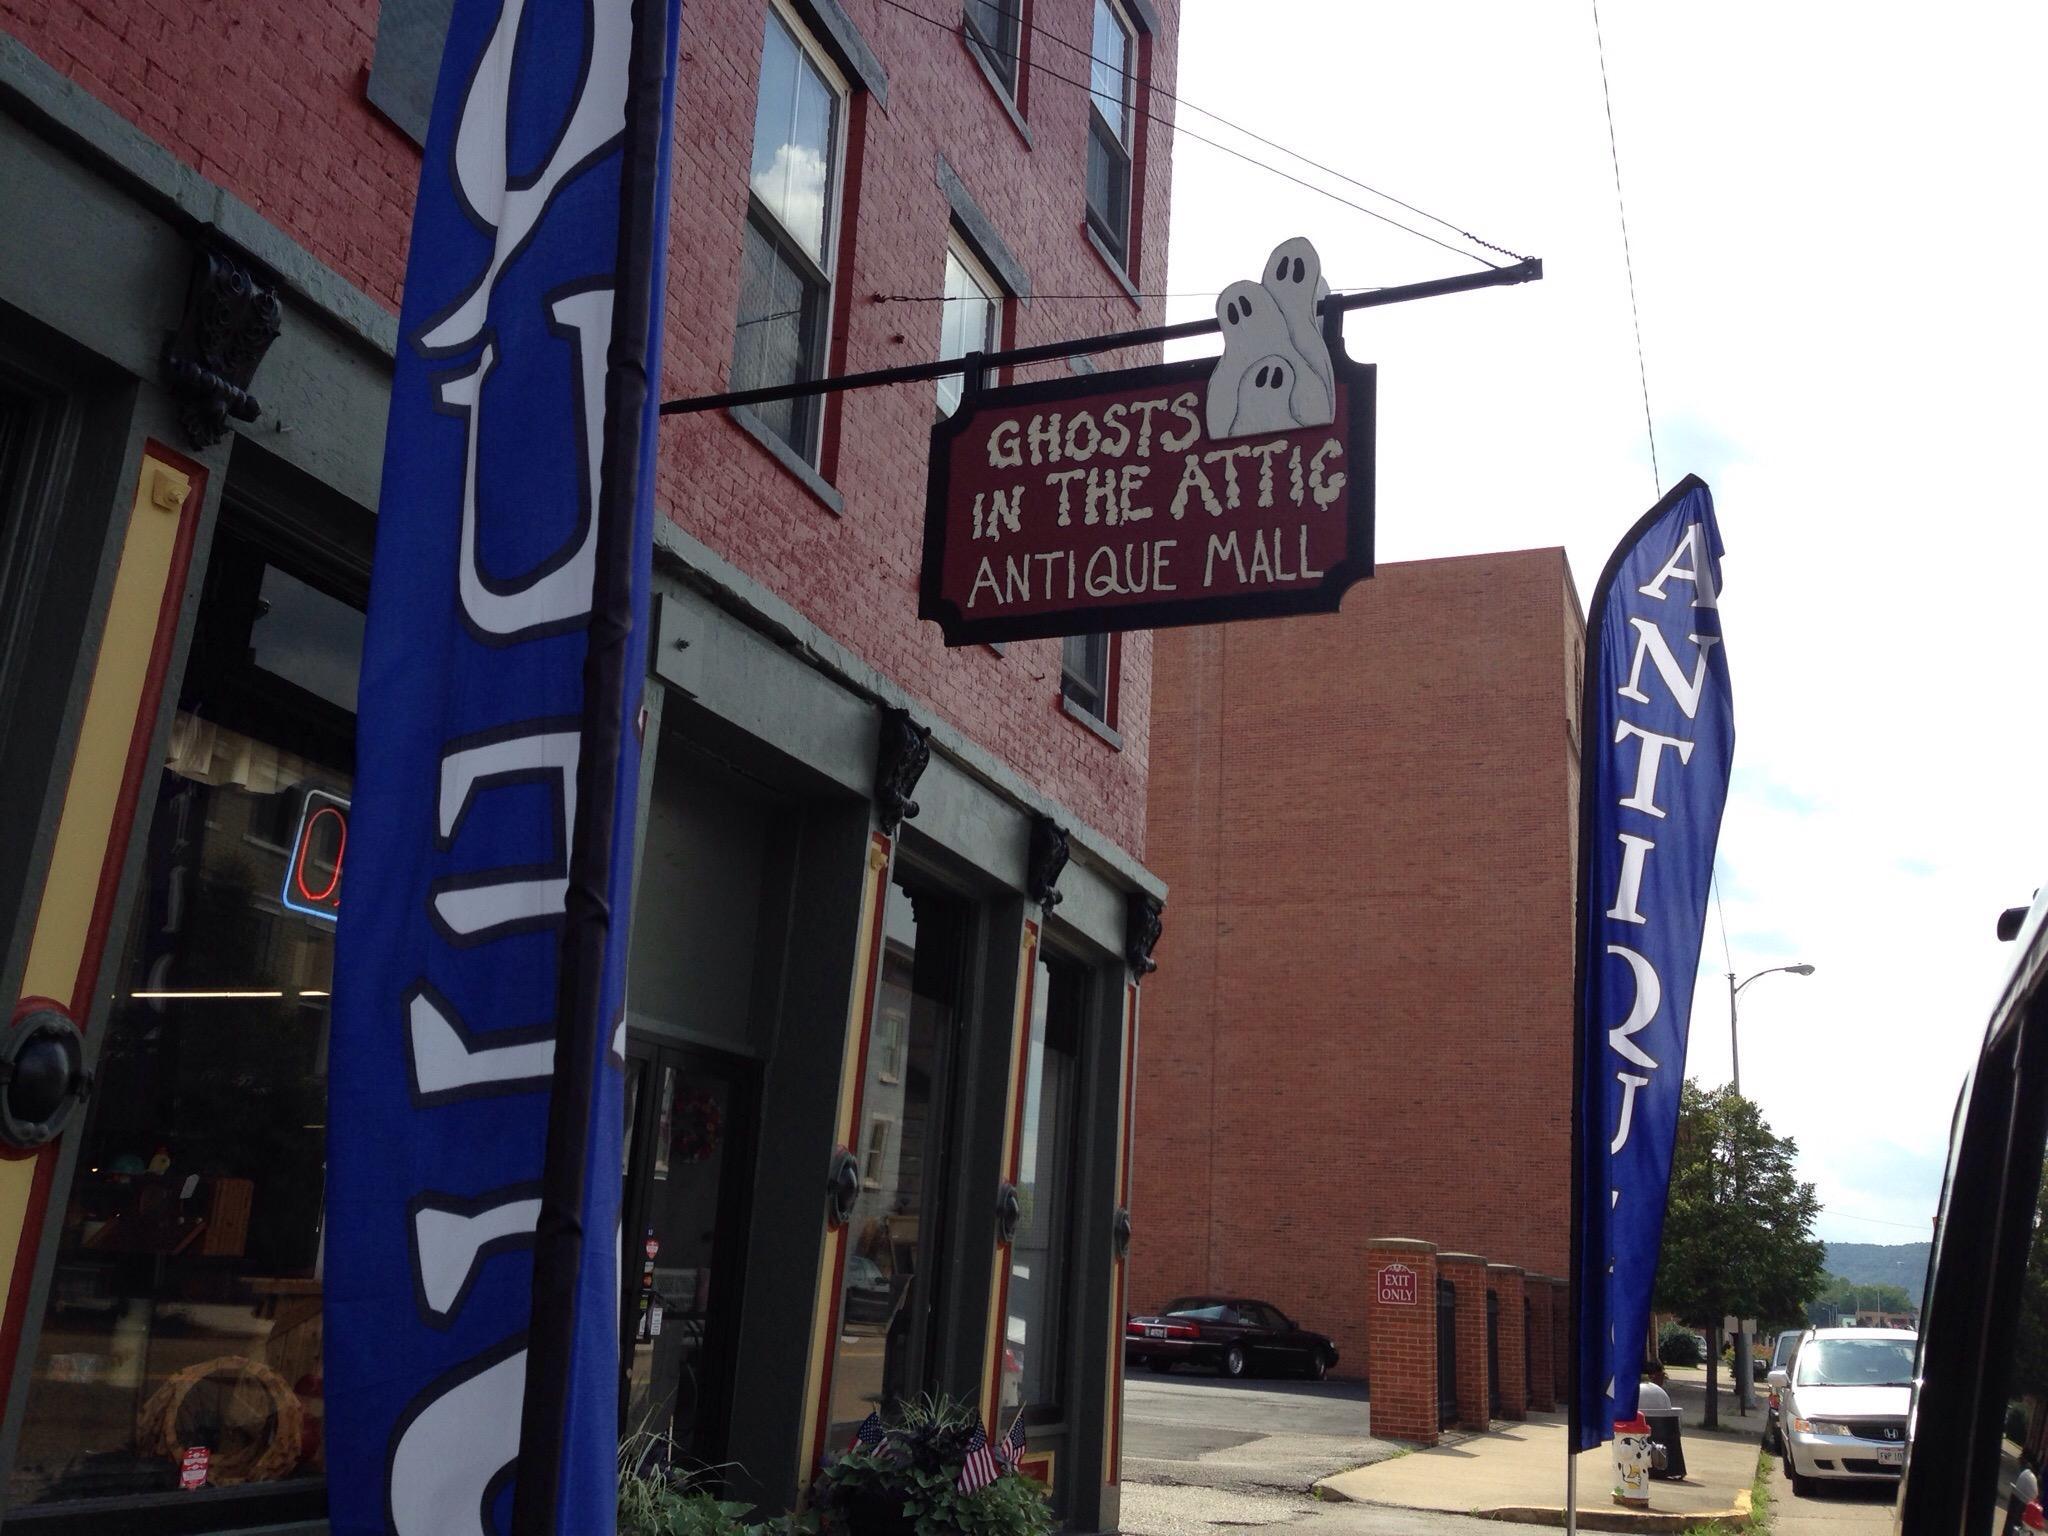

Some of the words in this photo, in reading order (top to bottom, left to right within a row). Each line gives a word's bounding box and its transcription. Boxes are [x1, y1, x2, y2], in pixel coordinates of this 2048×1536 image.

[986, 392, 1200, 469] GHOSTS
[972, 485, 1025, 542] IN
[1046, 464, 1154, 527] THE
[1170, 438, 1347, 521] ATTIC
[967, 540, 1178, 608] ANTIQUE
[1203, 524, 1324, 587] MALL
[1381, 1288, 1413, 1301] ONLY
[1385, 1274, 1410, 1287] EXIT
